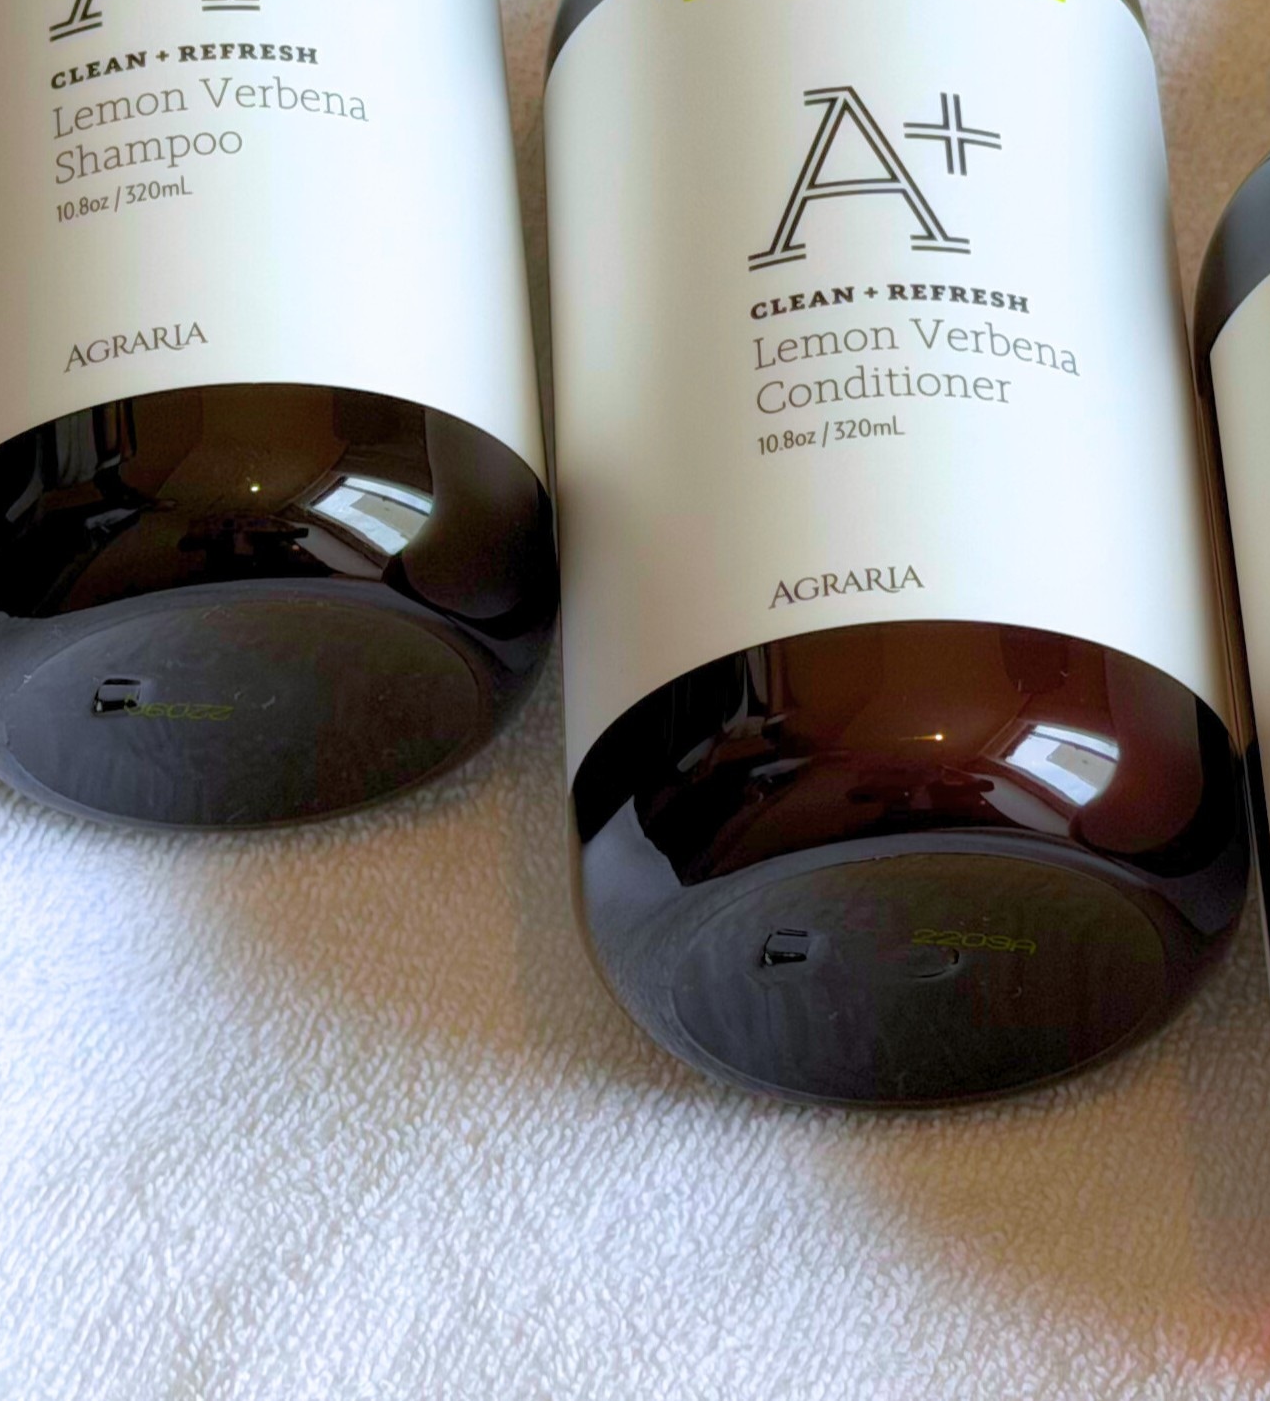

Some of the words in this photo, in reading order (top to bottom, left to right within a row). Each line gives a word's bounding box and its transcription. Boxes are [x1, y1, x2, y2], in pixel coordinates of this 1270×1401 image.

[50, 50, 148, 90] CLEAN
[177, 42, 319, 65] REFRESH
[52, 88, 189, 140] Lemon
[198, 72, 369, 122] Verbena
[55, 131, 243, 185] Shampoo
[56, 196, 110, 223] 10.8oz
[125, 175, 194, 205] 320mL
[749, 285, 855, 321] CLEAN
[886, 283, 1030, 314] REFRESH
[63, 321, 209, 373] AGRARIA
[752, 326, 900, 371] Lemon
[908, 313, 1081, 377] Verbena
[756, 364, 1012, 414] Conditioner
[757, 429, 817, 456] 10.8oz
[833, 415, 906, 441] 320mL
[768, 564, 926, 610] AGRARIA
